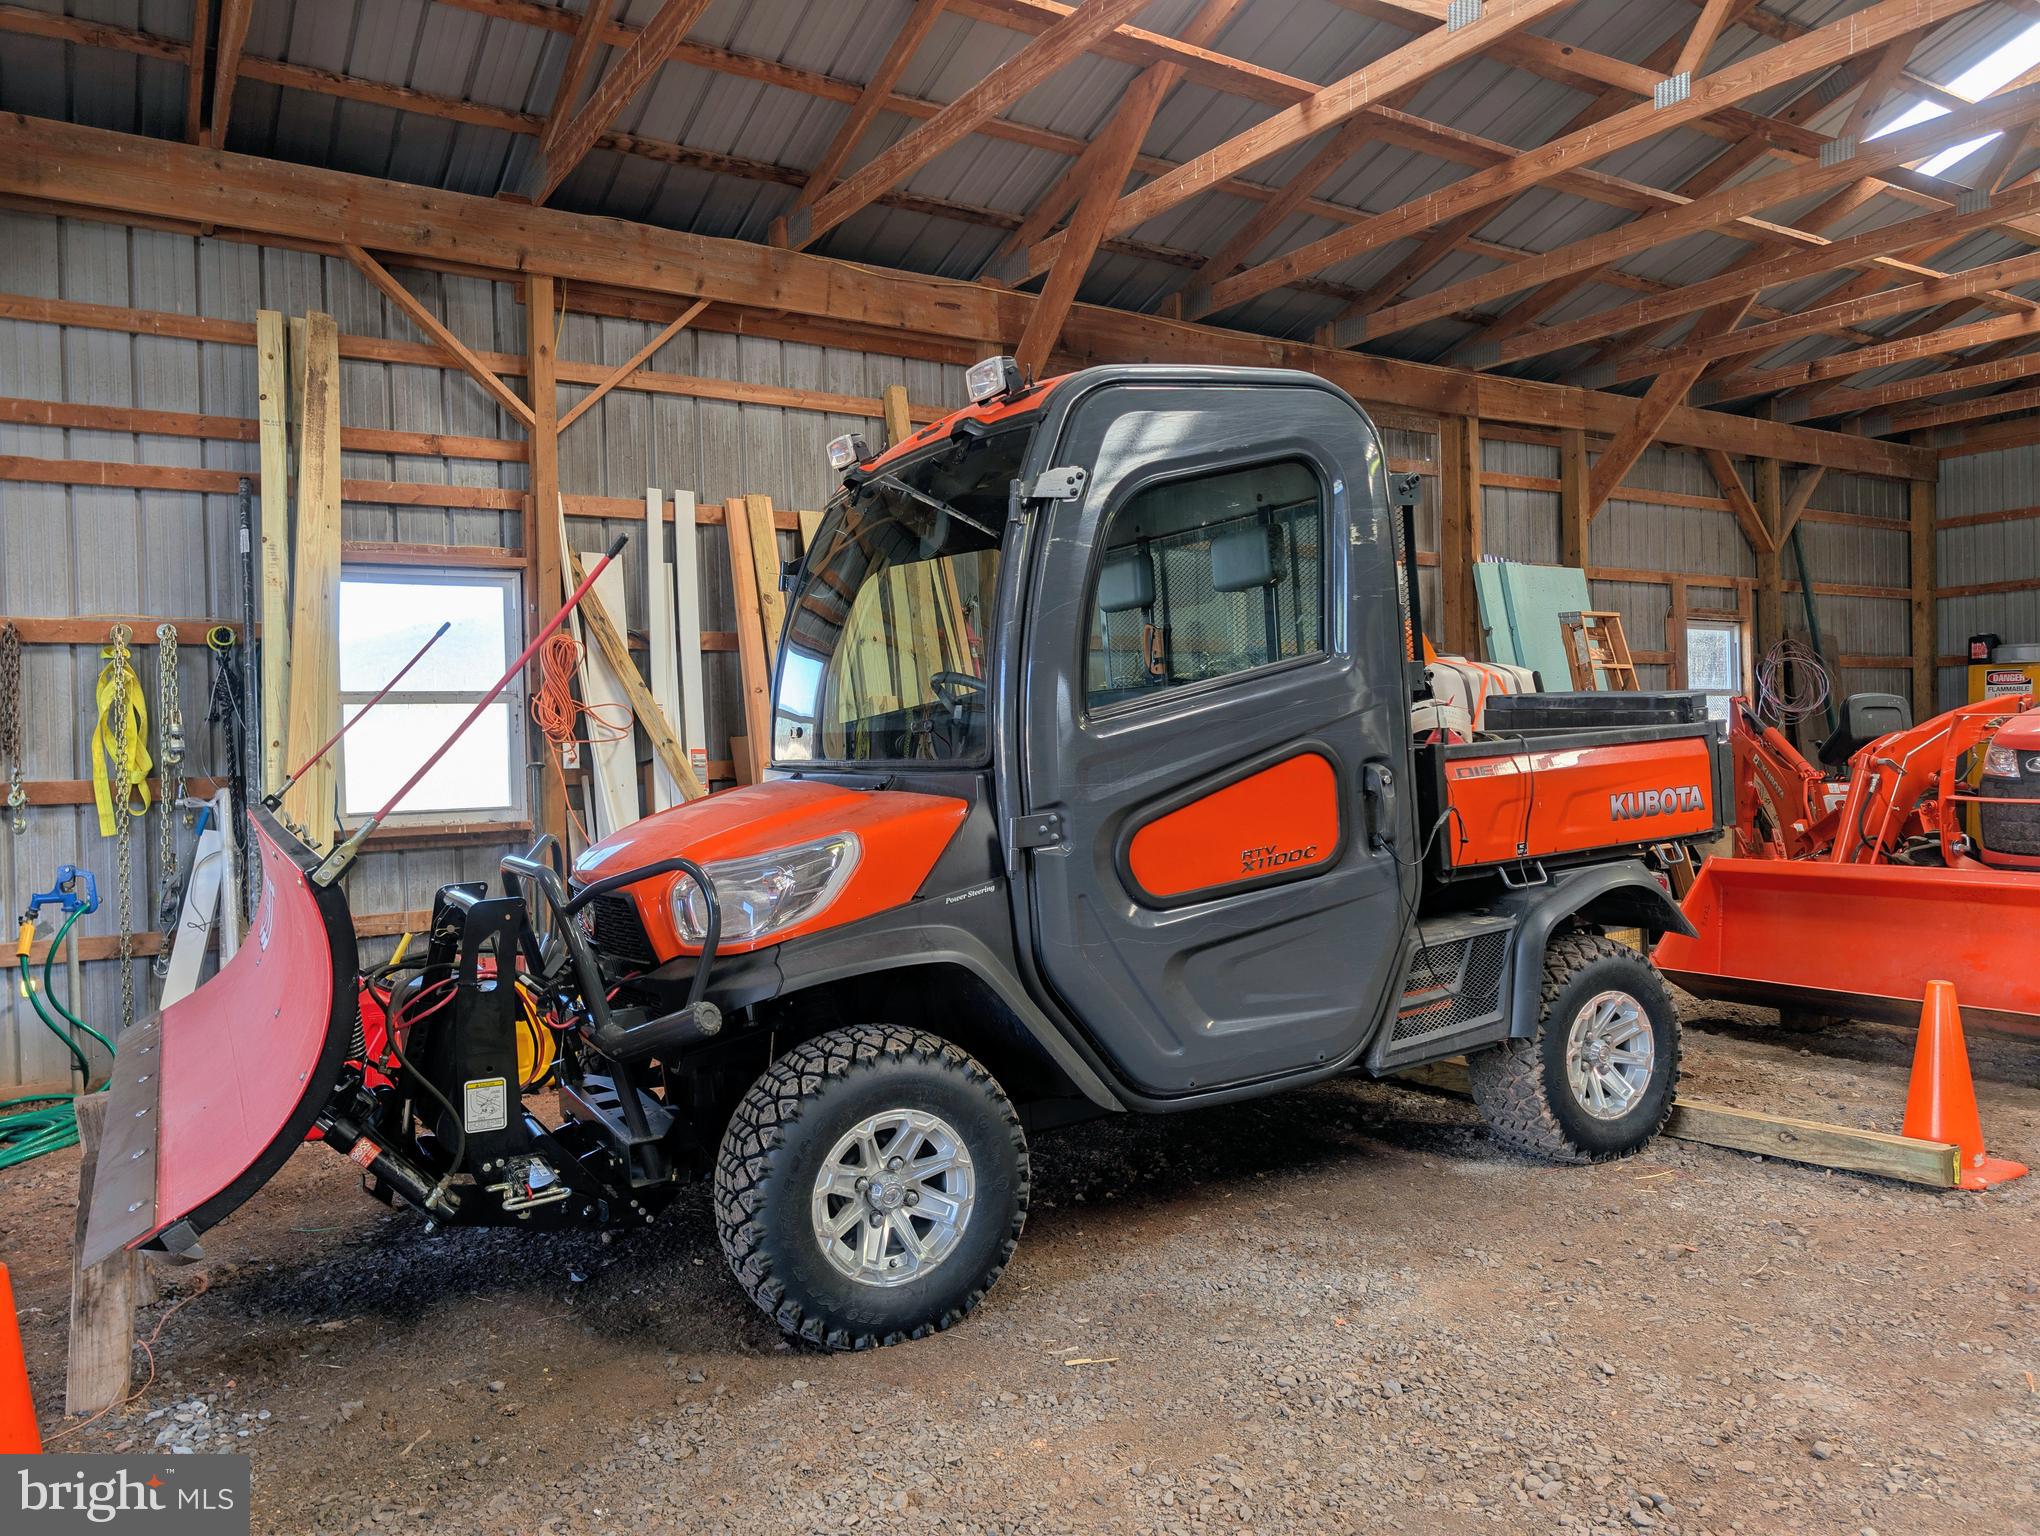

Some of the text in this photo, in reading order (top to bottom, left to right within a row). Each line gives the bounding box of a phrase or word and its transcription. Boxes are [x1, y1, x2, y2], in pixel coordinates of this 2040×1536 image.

[1993, 673, 2025, 683] DANGER
[1987, 685, 2030, 693] FLAMMABLE
[1609, 785, 1705, 821] KUBOTA
[1241, 845, 1317, 873] X1100C
[1242, 845, 1277, 860] RTV
[945, 885, 996, 905] Power Steering
